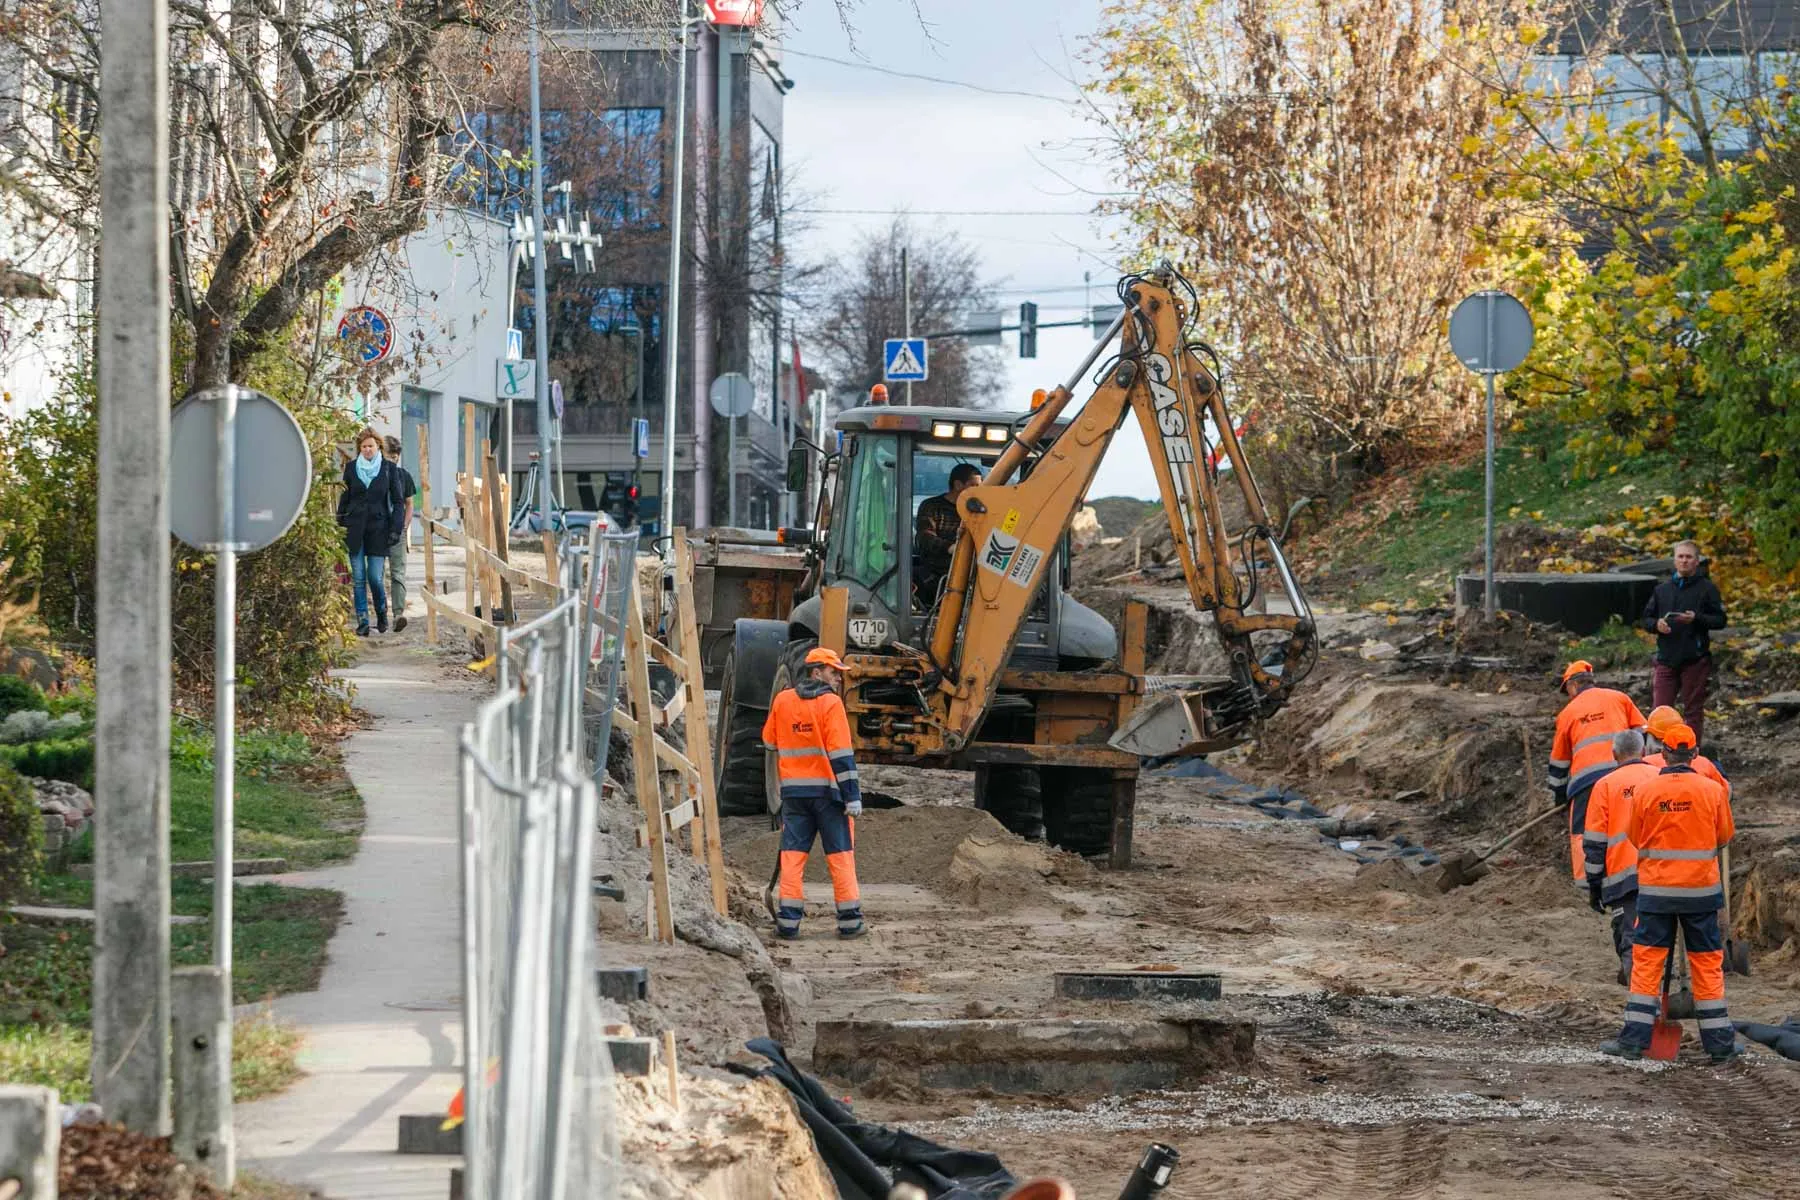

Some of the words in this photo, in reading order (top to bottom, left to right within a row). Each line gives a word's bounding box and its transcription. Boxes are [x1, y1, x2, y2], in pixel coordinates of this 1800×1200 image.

[1145, 352, 1193, 463] CASE
[853, 620, 867, 633] 17
[870, 620, 885, 634] 10
[860, 634, 877, 645] LE
